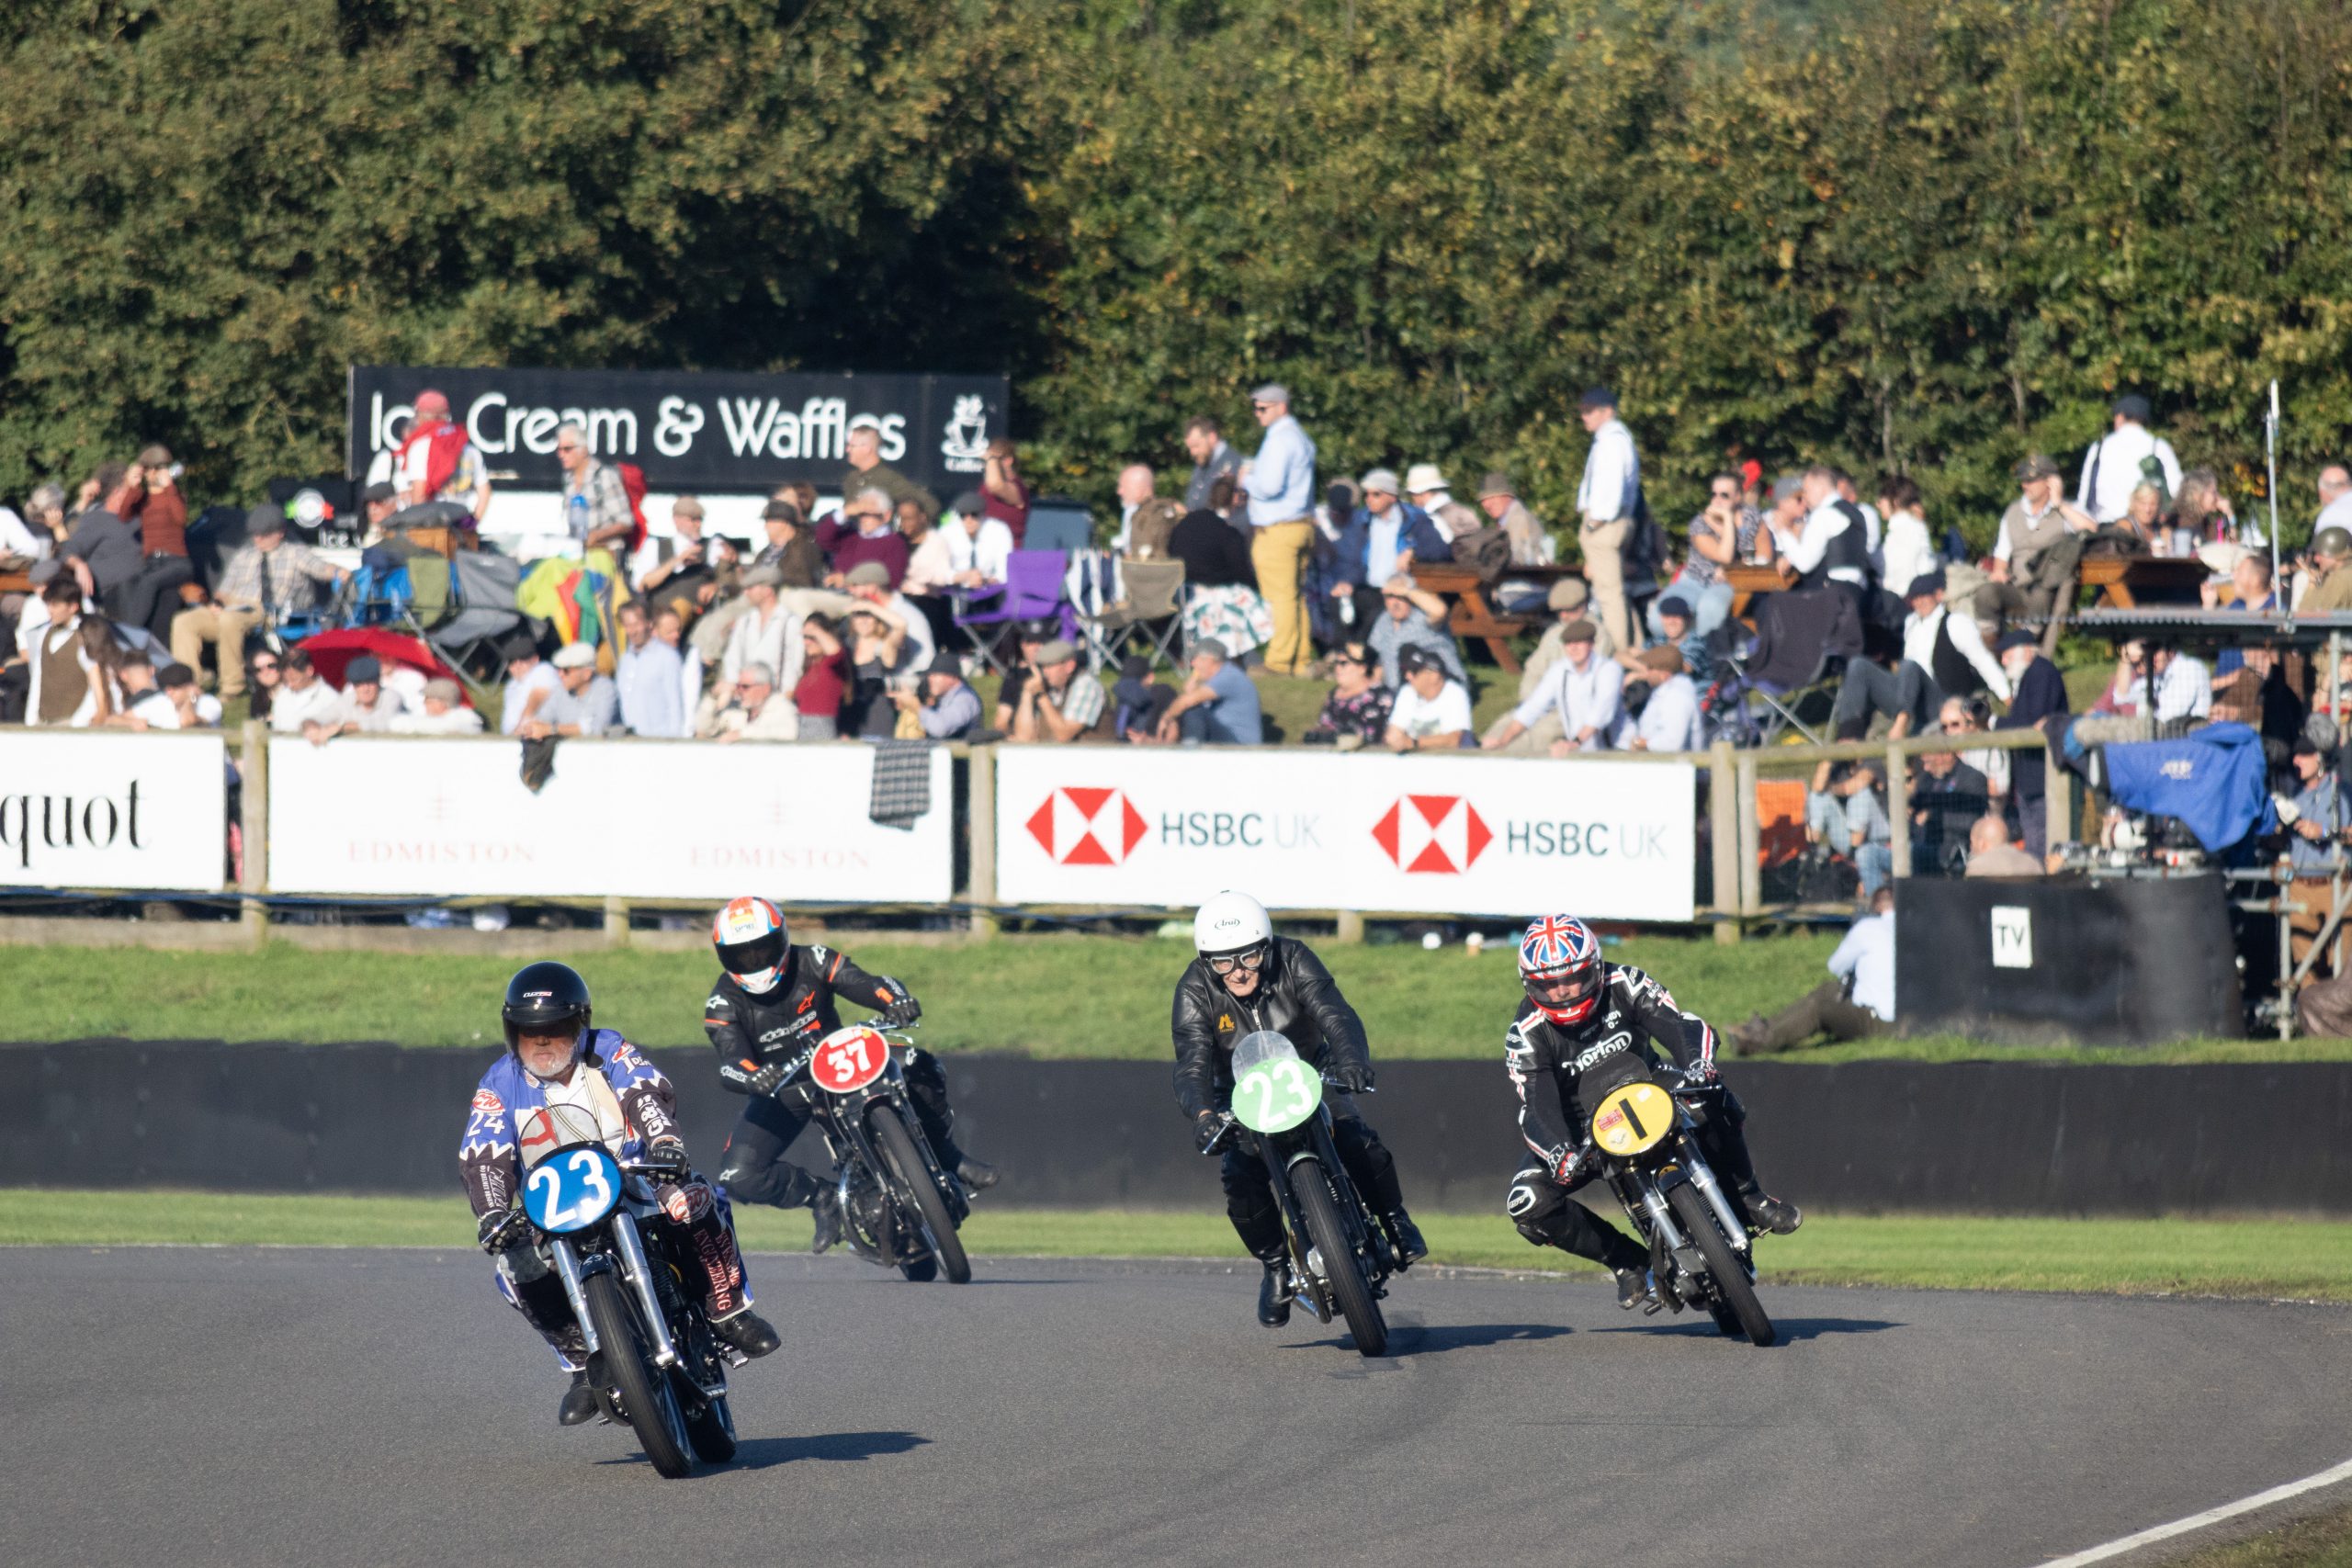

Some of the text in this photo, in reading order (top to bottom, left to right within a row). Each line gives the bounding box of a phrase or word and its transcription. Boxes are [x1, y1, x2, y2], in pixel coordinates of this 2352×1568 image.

[370, 390, 441, 452] Ic
[654, 395, 705, 457] &
[0, 779, 153, 869] quot
[1161, 812, 1323, 849] HSBC UK
[1507, 820, 1668, 860] HSBC UK
[348, 842, 536, 862] EDMISTON
[690, 847, 871, 868] EDMISTON
[1996, 924, 2025, 948] TV
[827, 1039, 872, 1083] 37
[1562, 1031, 1633, 1077] Norton
[1241, 1059, 1314, 1131] 23
[467, 1110, 505, 1137] 24
[1618, 1098, 1648, 1141] 1
[528, 1149, 611, 1230] 23
